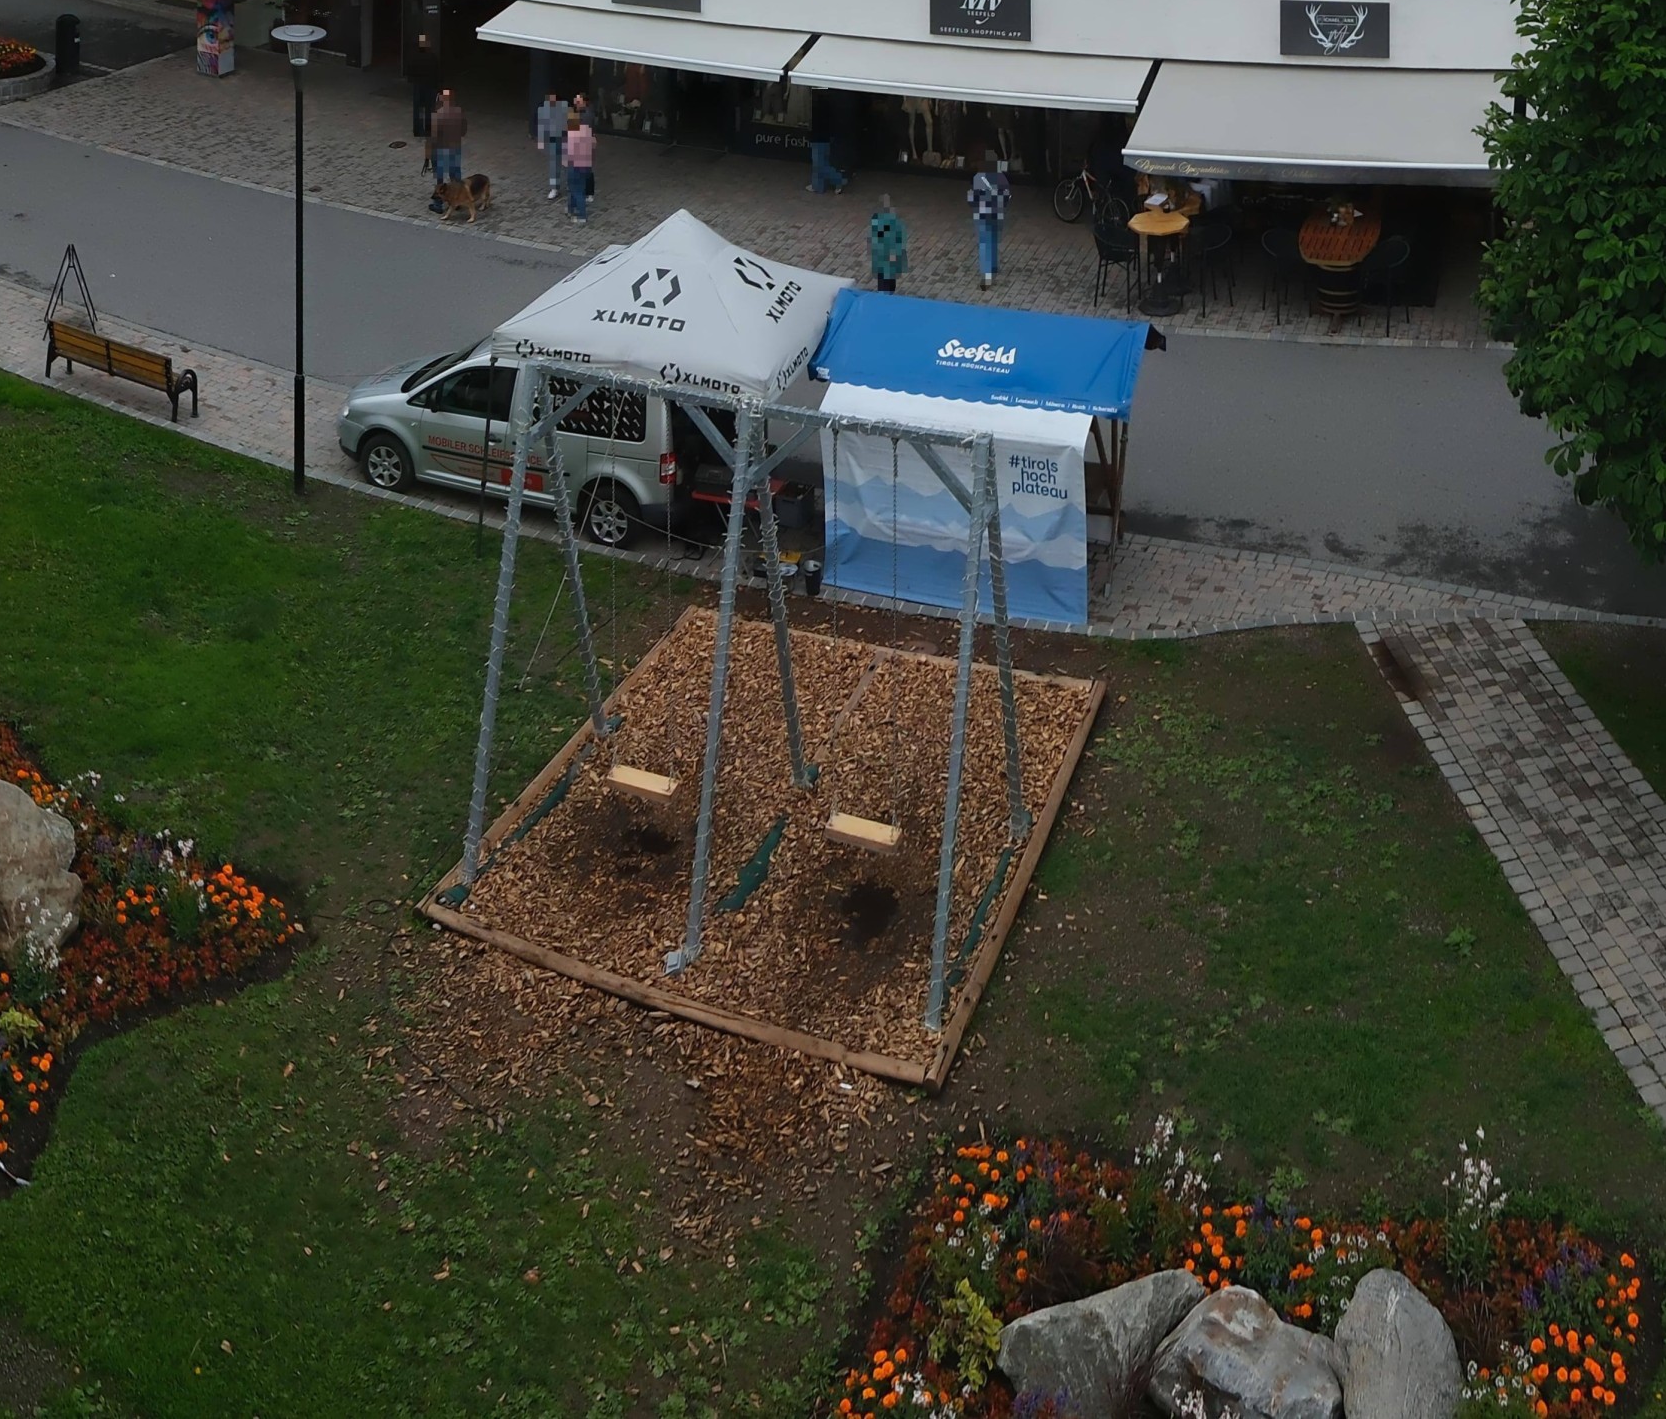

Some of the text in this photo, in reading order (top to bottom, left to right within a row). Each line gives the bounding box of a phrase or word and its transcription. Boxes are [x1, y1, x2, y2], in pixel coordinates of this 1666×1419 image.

[967, 10, 996, 18] SEEFELD
[940, 26, 969, 34] SEEFELD
[971, 28, 1004, 37] SHOPPING
[755, 132, 781, 146] pure
[765, 280, 802, 324] XLMOTO
[591, 308, 685, 332] XLMOTO
[538, 345, 591, 363] XLMOTO
[937, 339, 1017, 365] Seefeld
[785, 346, 809, 379] XLMOTO
[936, 359, 1010, 374] TIROLS HOCHPLATEAU
[683, 371, 740, 394] XLMOTO
[428, 436, 466, 450] MOBILER
[1009, 455, 1058, 472] #tirols
[1021, 467, 1056, 485] hoch
[1013, 481, 1068, 500] plateau
